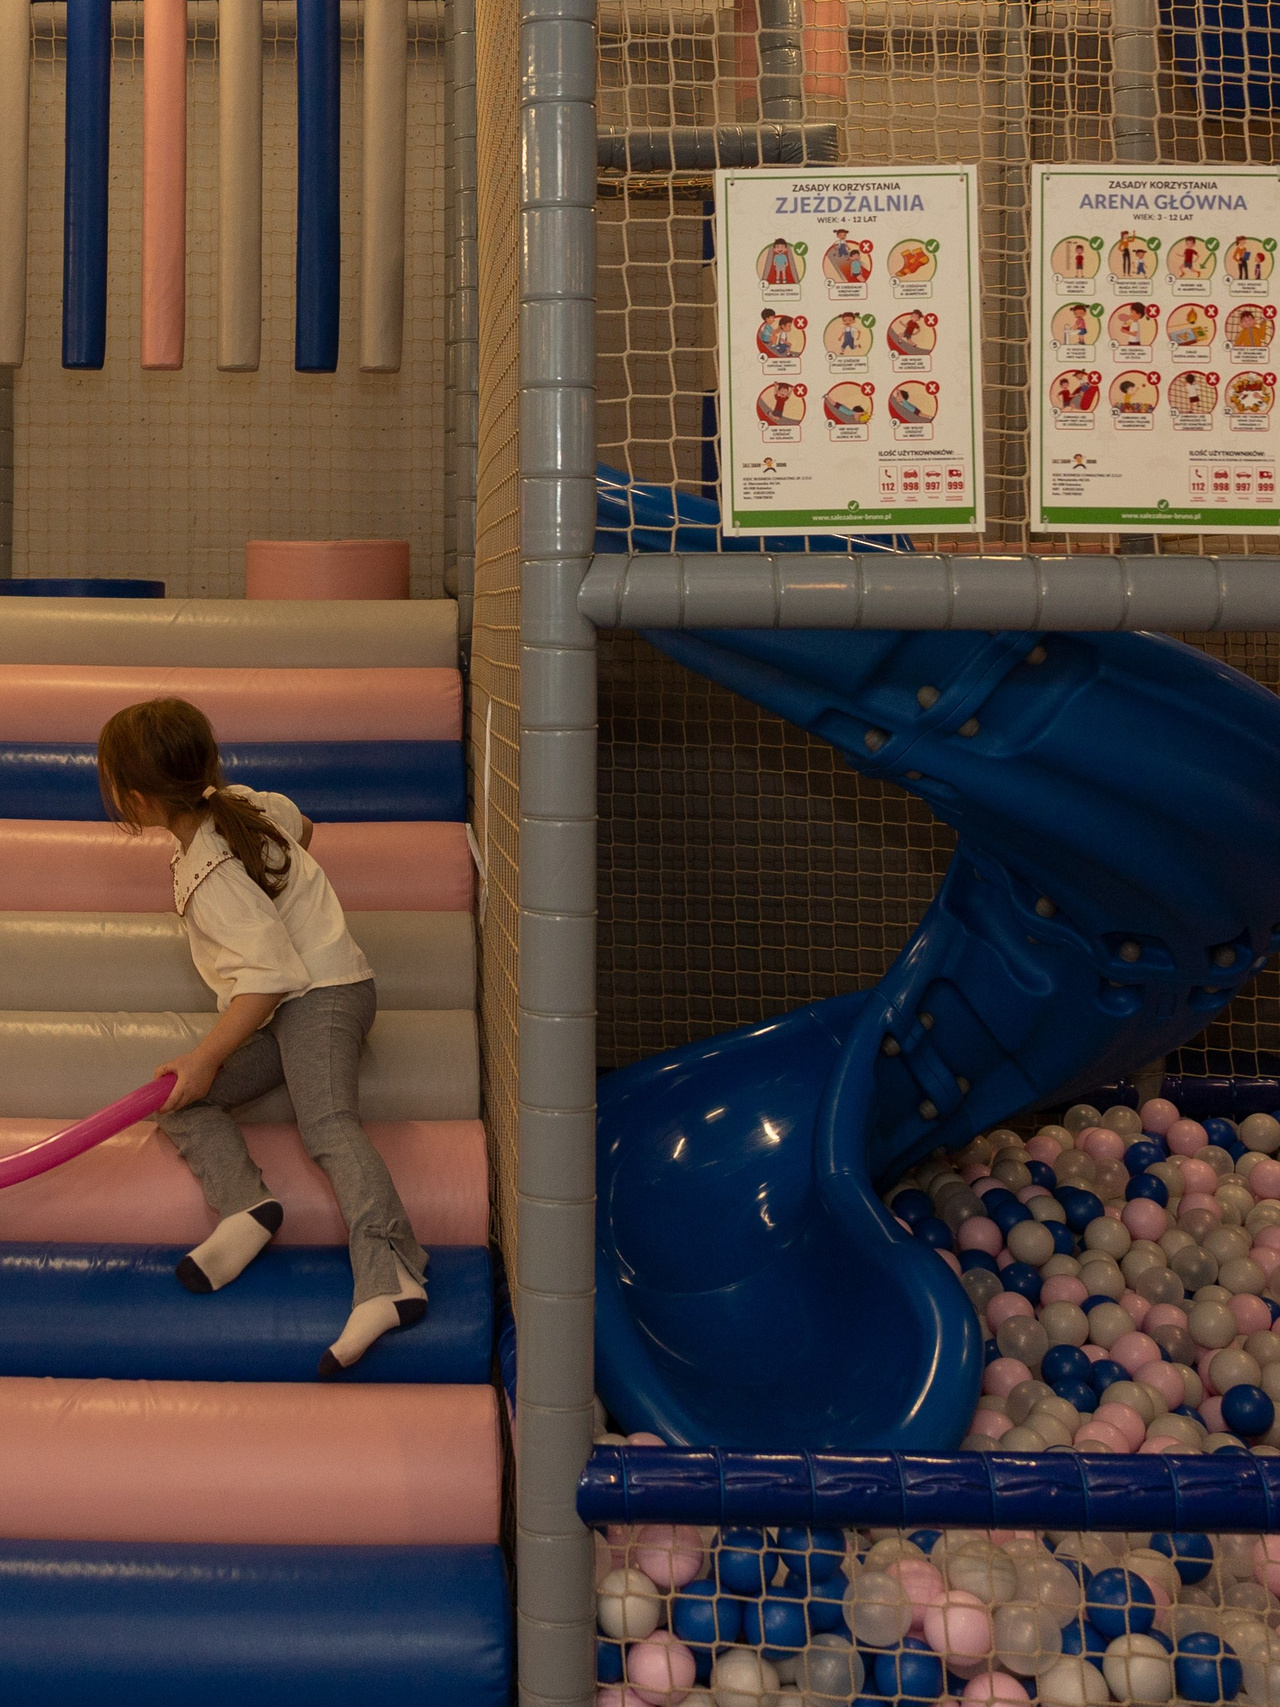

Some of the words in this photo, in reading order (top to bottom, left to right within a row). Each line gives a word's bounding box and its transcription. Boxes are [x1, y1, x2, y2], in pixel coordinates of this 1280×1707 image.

[792, 184, 830, 192] ZASADY
[833, 182, 901, 191] KORZYSTANIA
[1109, 181, 1148, 189] ZASADY
[1149, 181, 1218, 189] KORZYSTANIA
[775, 192, 925, 214] ZJEŻDŻALNIA
[1080, 193, 1149, 210] ARENA
[1154, 191, 1248, 211] GŁÓWNA
[817, 216, 839, 224] WIEK:
[1133, 213, 1156, 221] WIEK:
[1179, 213, 1194, 221] LAT
[882, 482, 895, 491] 112
[903, 482, 919, 491] 998
[925, 481, 940, 490] 997
[947, 481, 964, 490] 999
[1192, 482, 1205, 491] 112
[1213, 482, 1229, 491] 998
[1235, 482, 1250, 491] 997
[1258, 483, 1274, 492] 999
